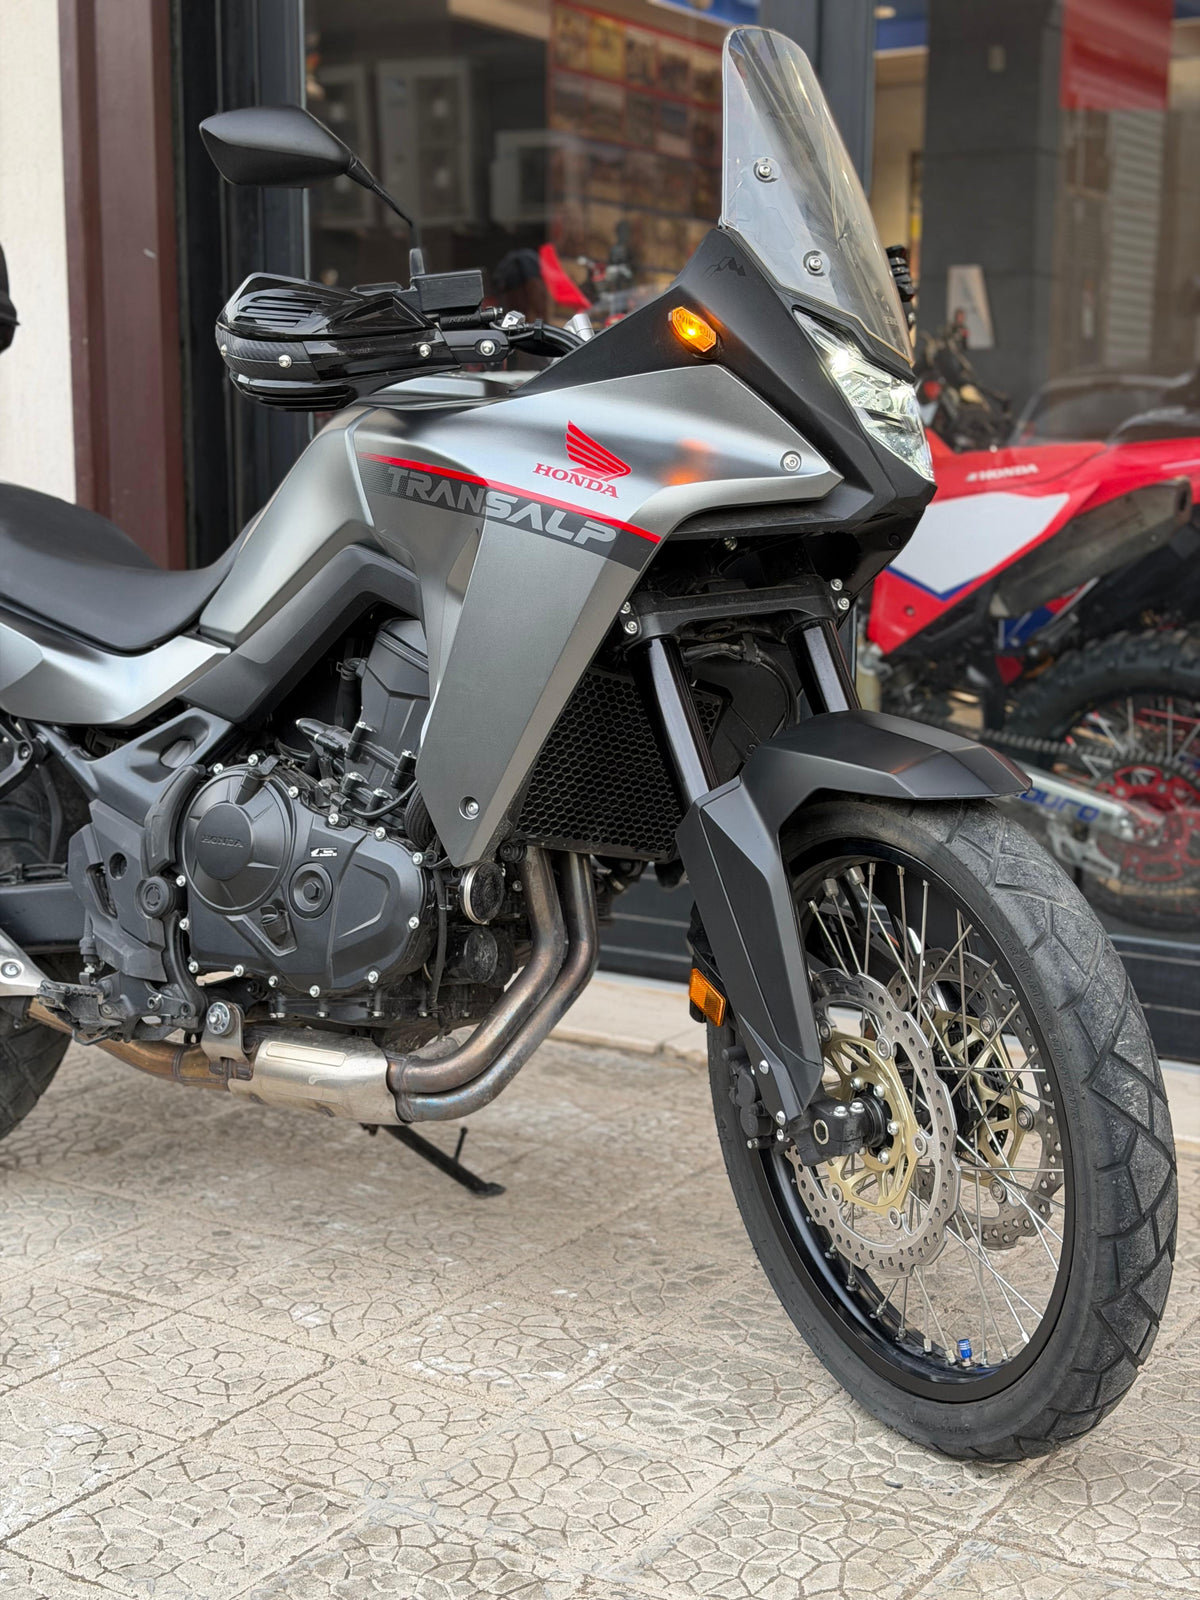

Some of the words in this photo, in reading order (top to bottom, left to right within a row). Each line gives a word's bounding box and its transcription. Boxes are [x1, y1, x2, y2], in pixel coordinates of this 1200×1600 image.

[533, 462, 619, 498] HONDA
[979, 463, 1039, 481] HONDA
[388, 467, 616, 545] TRANSALP
[201, 834, 244, 848] HONDA
